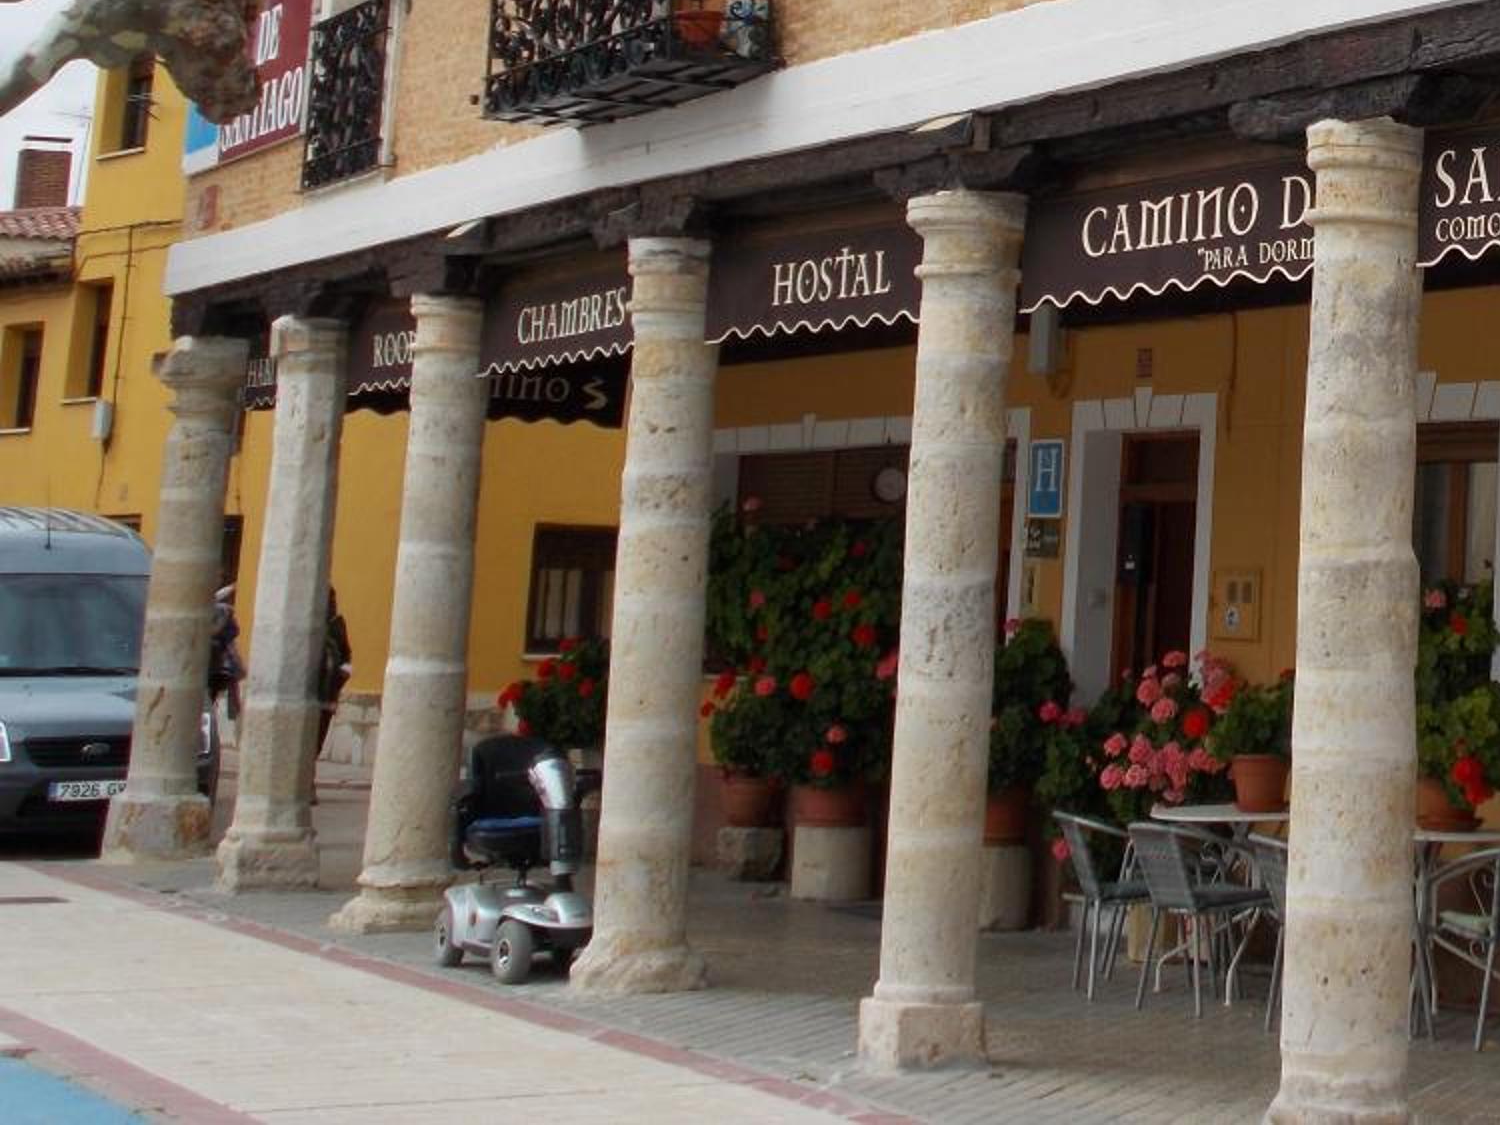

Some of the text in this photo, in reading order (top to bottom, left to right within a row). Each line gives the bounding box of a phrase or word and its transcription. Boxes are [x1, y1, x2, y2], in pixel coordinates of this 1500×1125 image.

[256, 4, 283, 66] DE
[1081, 182, 1259, 258] CAMINO
[1280, 175, 1311, 230] D
[771, 244, 892, 308] HOSTAL
[517, 286, 627, 345] CHAMBRES
